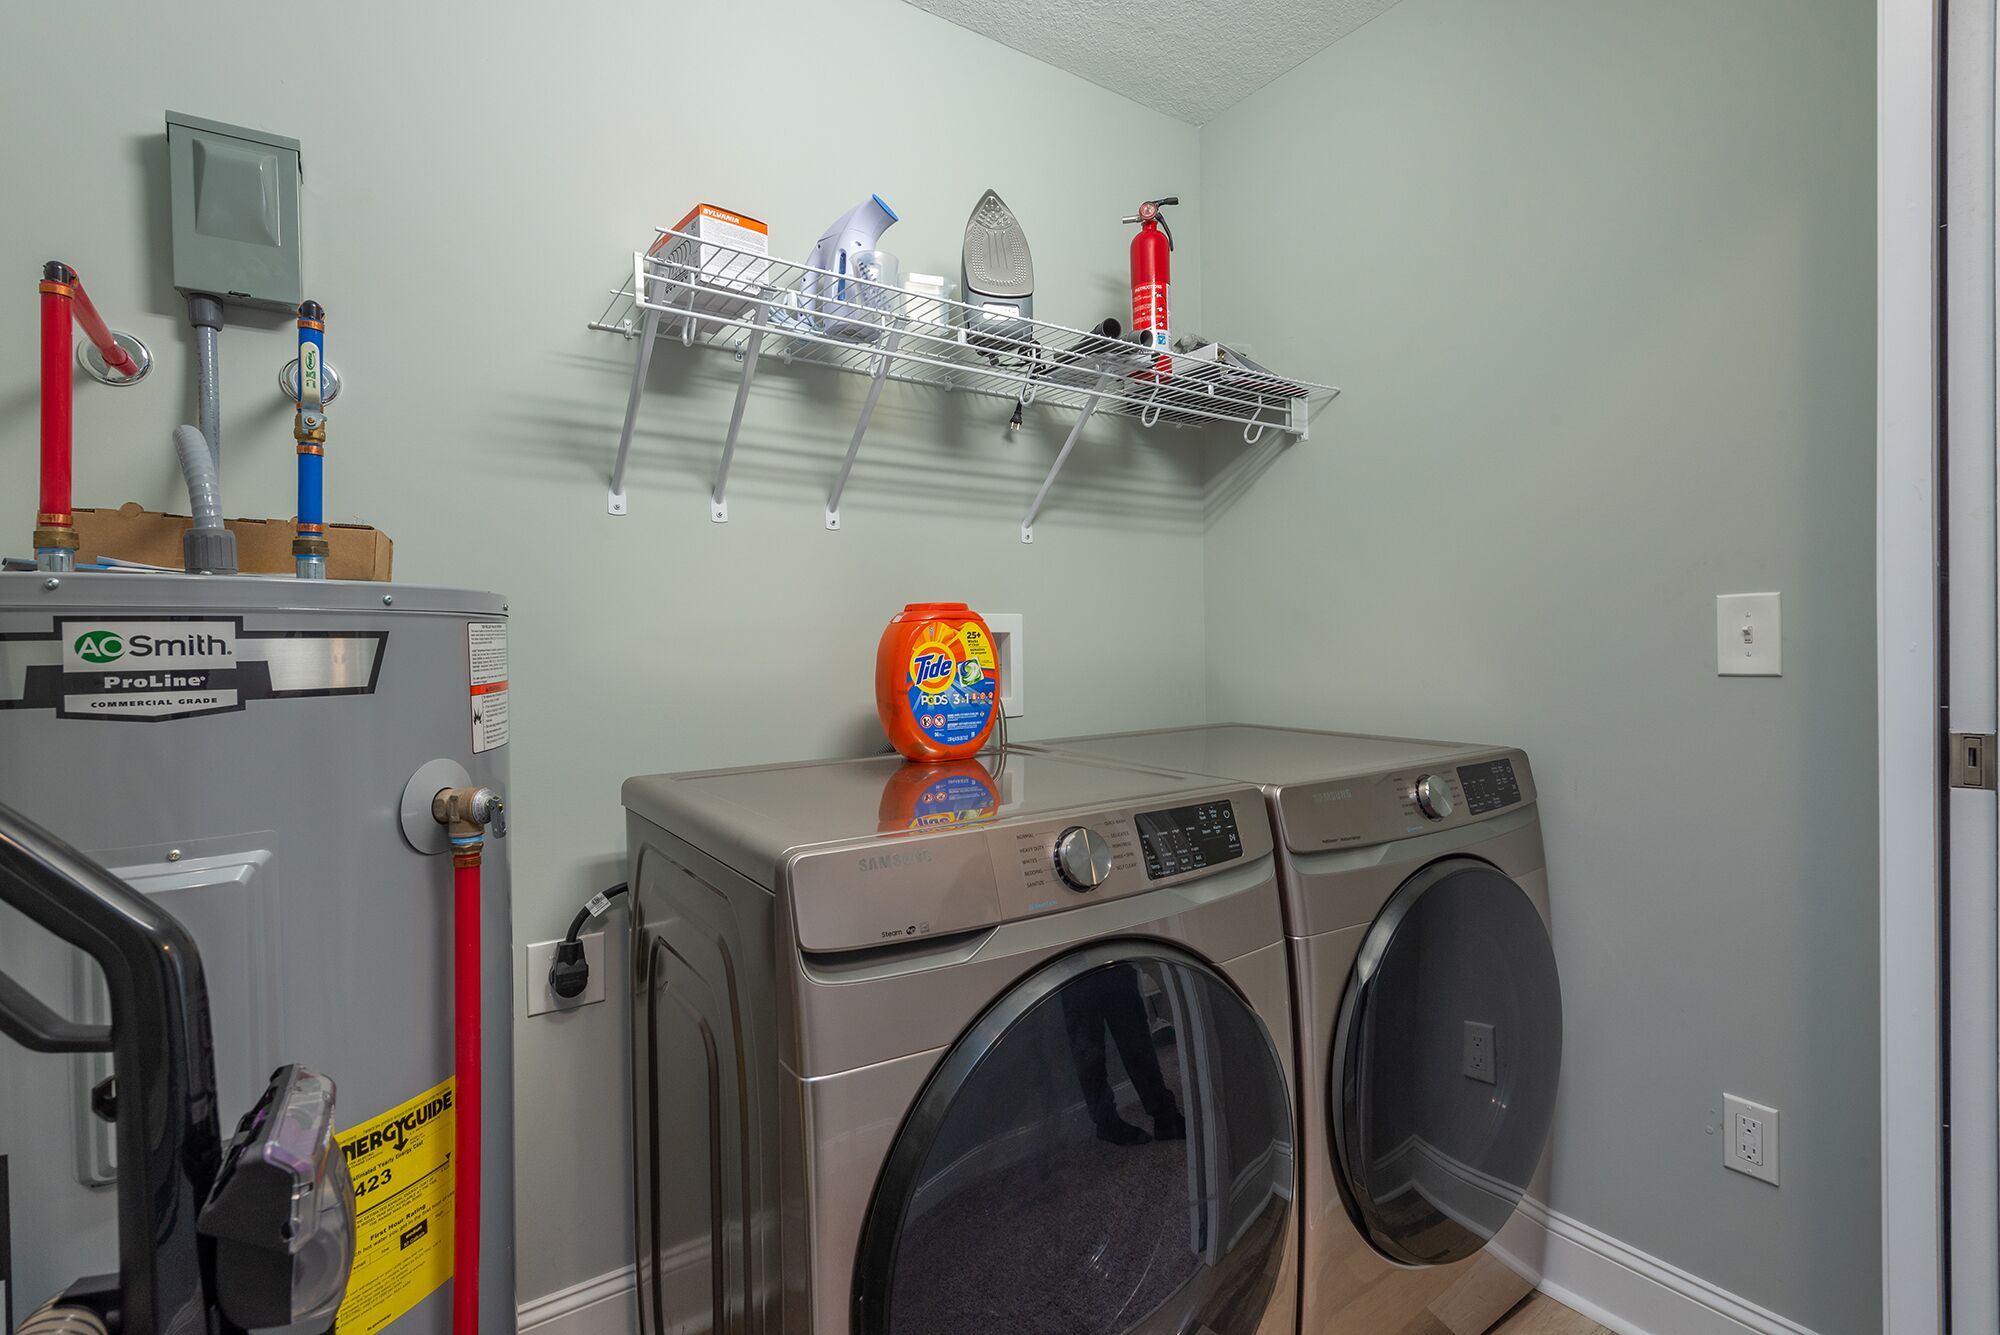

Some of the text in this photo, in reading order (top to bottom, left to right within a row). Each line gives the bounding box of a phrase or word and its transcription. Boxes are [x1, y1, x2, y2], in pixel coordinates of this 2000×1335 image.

[702, 207, 740, 224] SYLVANIA
[966, 631, 982, 639] 25+
[914, 653, 953, 687] Tide
[103, 675, 201, 689] ProLine
[90, 697, 218, 708] COMMERCIAL GRADE
[921, 694, 948, 706] PODS
[1020, 846, 1033, 854] HEAVY
[858, 848, 933, 872] SAMSUNG
[881, 929, 903, 938] Steam
[341, 1091, 452, 1163] NERGYGUIDE
[378, 1156, 394, 1168] Yearly
[395, 1148, 412, 1160] Energy
[413, 1140, 424, 1150] Cost
[354, 1168, 393, 1198] 423
[370, 1203, 426, 1241] First Hour Rating
